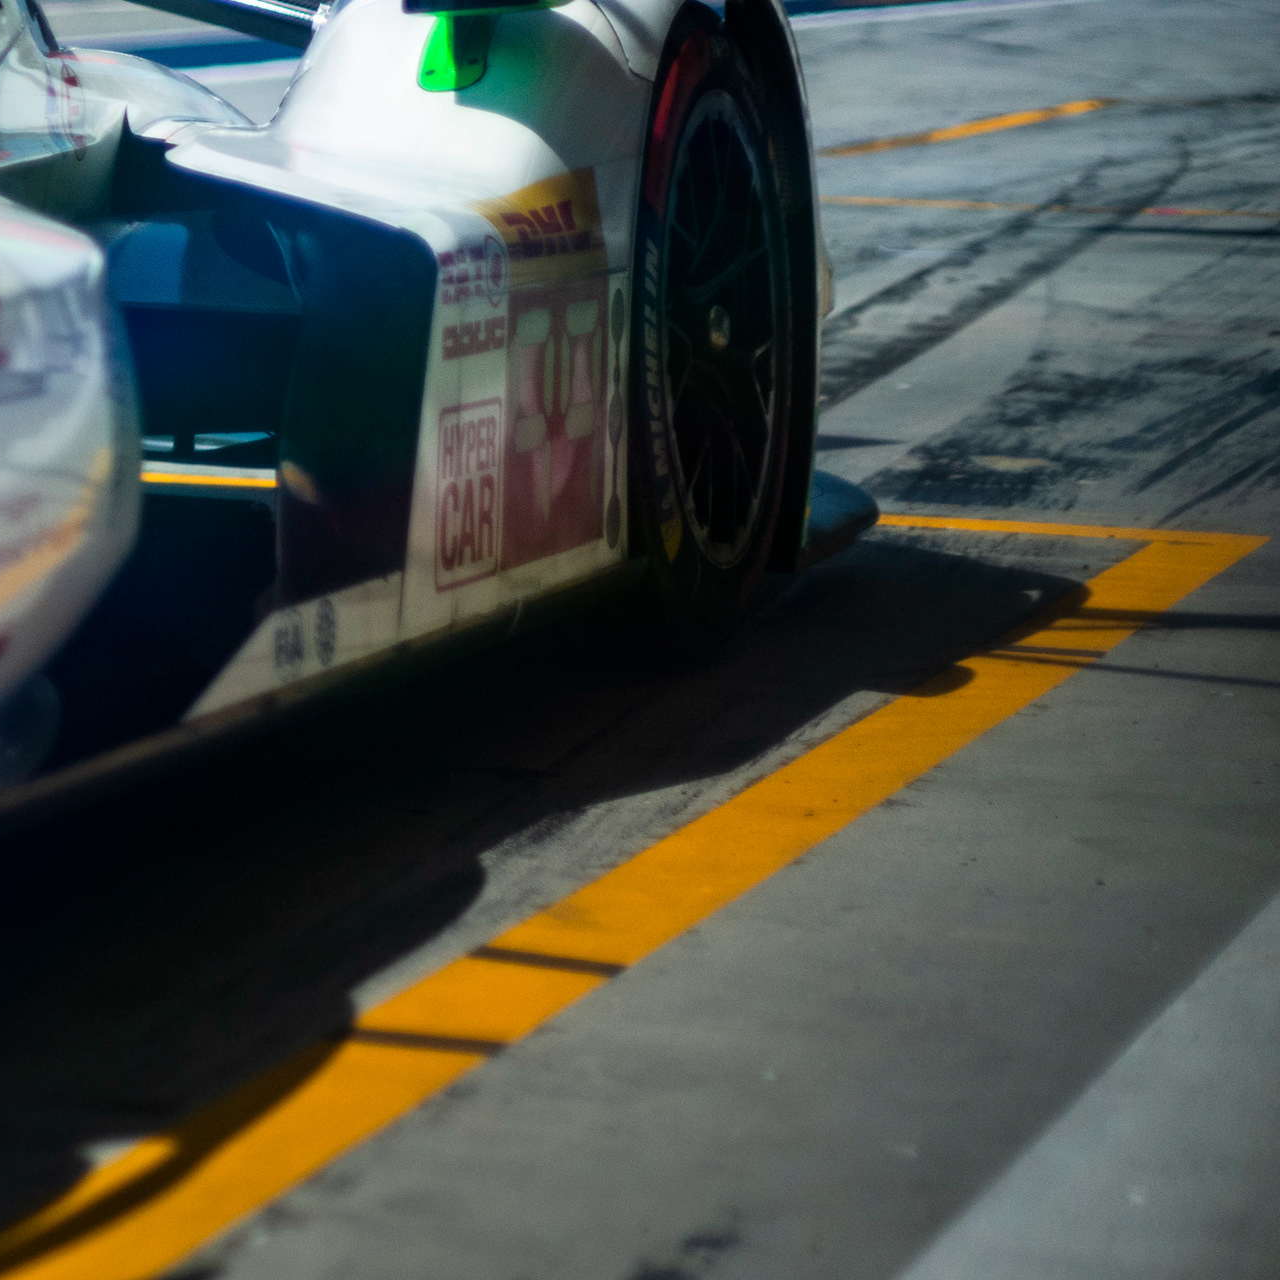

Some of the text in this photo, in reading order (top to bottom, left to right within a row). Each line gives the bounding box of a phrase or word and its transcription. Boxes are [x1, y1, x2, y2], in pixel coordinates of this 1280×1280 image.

[643, 237, 668, 477] MICHELIN
[441, 415, 496, 481] HYPER
[440, 473, 495, 571] CAR
